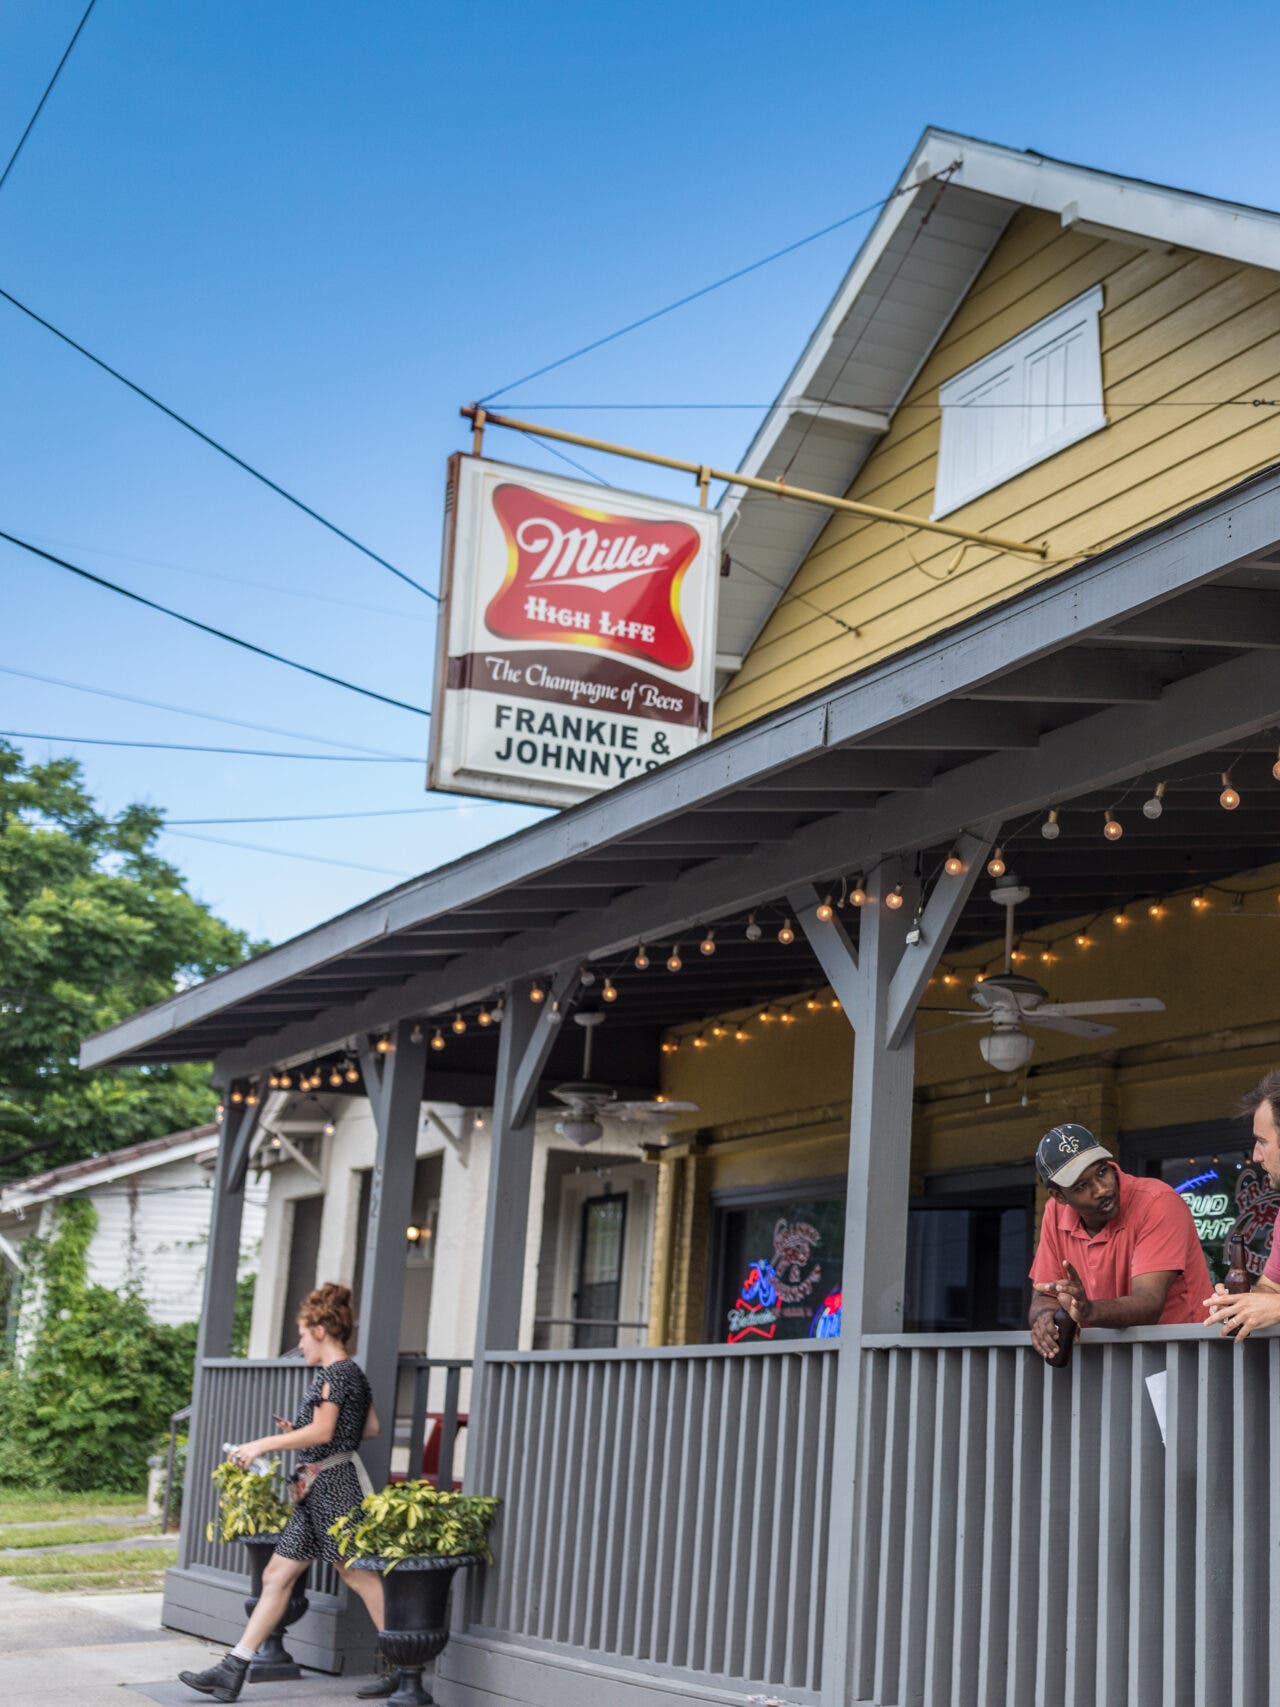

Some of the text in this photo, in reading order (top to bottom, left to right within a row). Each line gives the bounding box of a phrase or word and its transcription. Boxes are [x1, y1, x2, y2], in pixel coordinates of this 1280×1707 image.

[516, 517, 670, 580] Miller
[524, 595, 655, 643] HIGH LIFE
[485, 655, 684, 712] The Champagne of Beers
[495, 704, 670, 755] FRANKIE &
